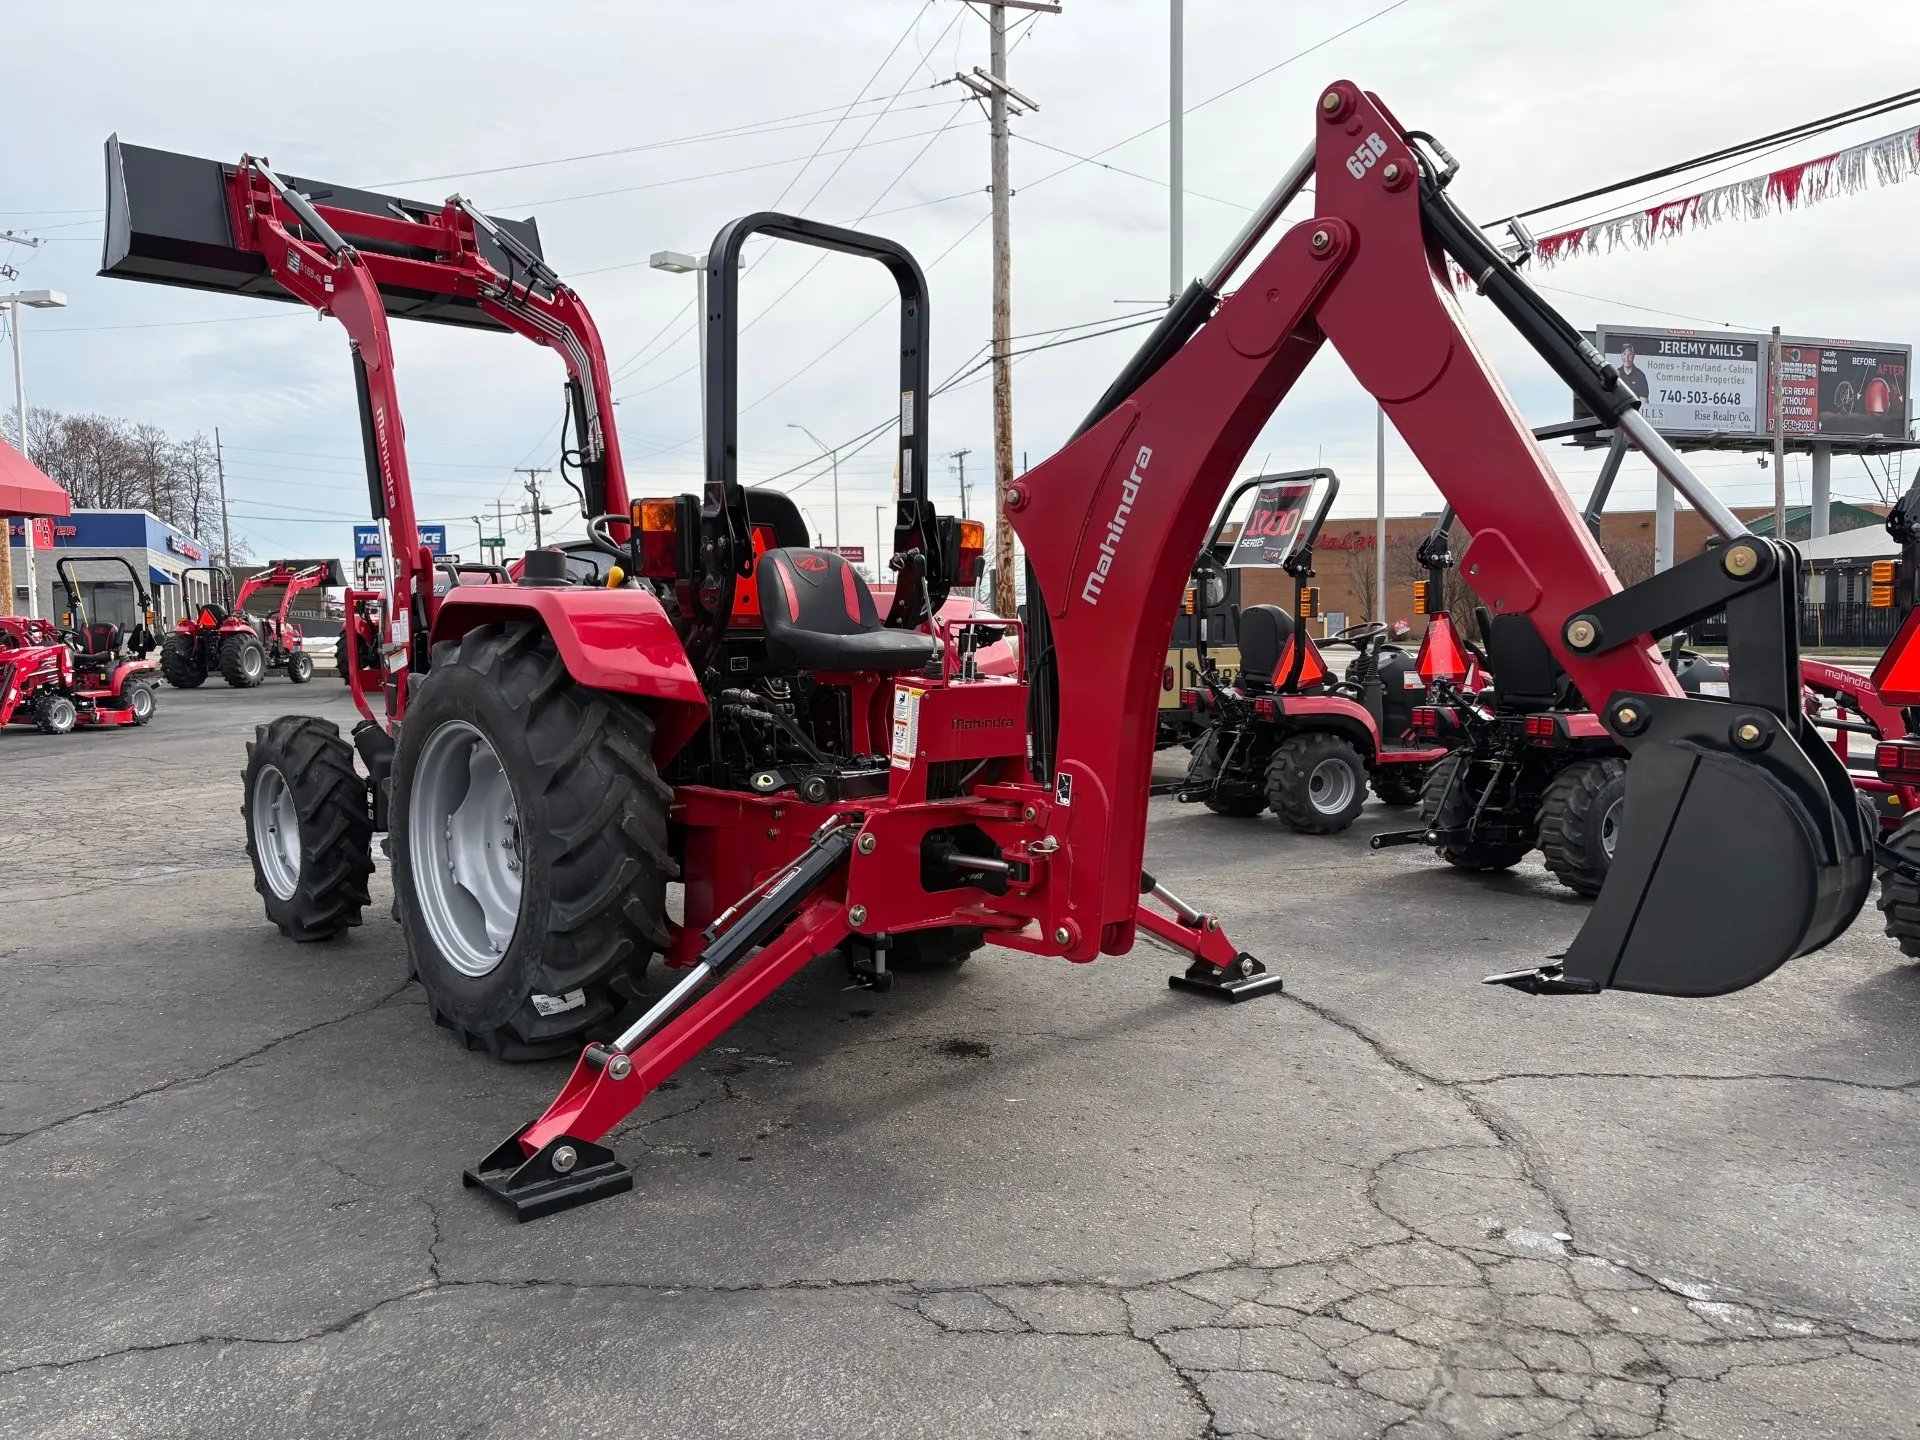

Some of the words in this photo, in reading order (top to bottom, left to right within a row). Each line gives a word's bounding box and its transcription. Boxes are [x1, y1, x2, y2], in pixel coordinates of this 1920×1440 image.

[1346, 132, 1388, 180] 65B
[1658, 340, 1707, 356] JEREMY
[1709, 343, 1744, 358] MILLS
[1647, 360, 1674, 371] Homes
[1728, 364, 1754, 374] Cabins
[1851, 357, 1877, 367] BEFORE
[1877, 364, 1905, 376] AFTER
[1656, 372, 1704, 384] Commercial
[1704, 374, 1745, 386] Properties
[1659, 389, 1741, 406] 740-503-6648
[1793, 386, 1816, 397] REPAIR
[1694, 410, 1711, 421] Rise
[1712, 410, 1737, 425] Realty
[1738, 411, 1751, 422] Co.
[357, 533, 381, 545] TIR
[1823, 668, 1871, 690] mahindra
